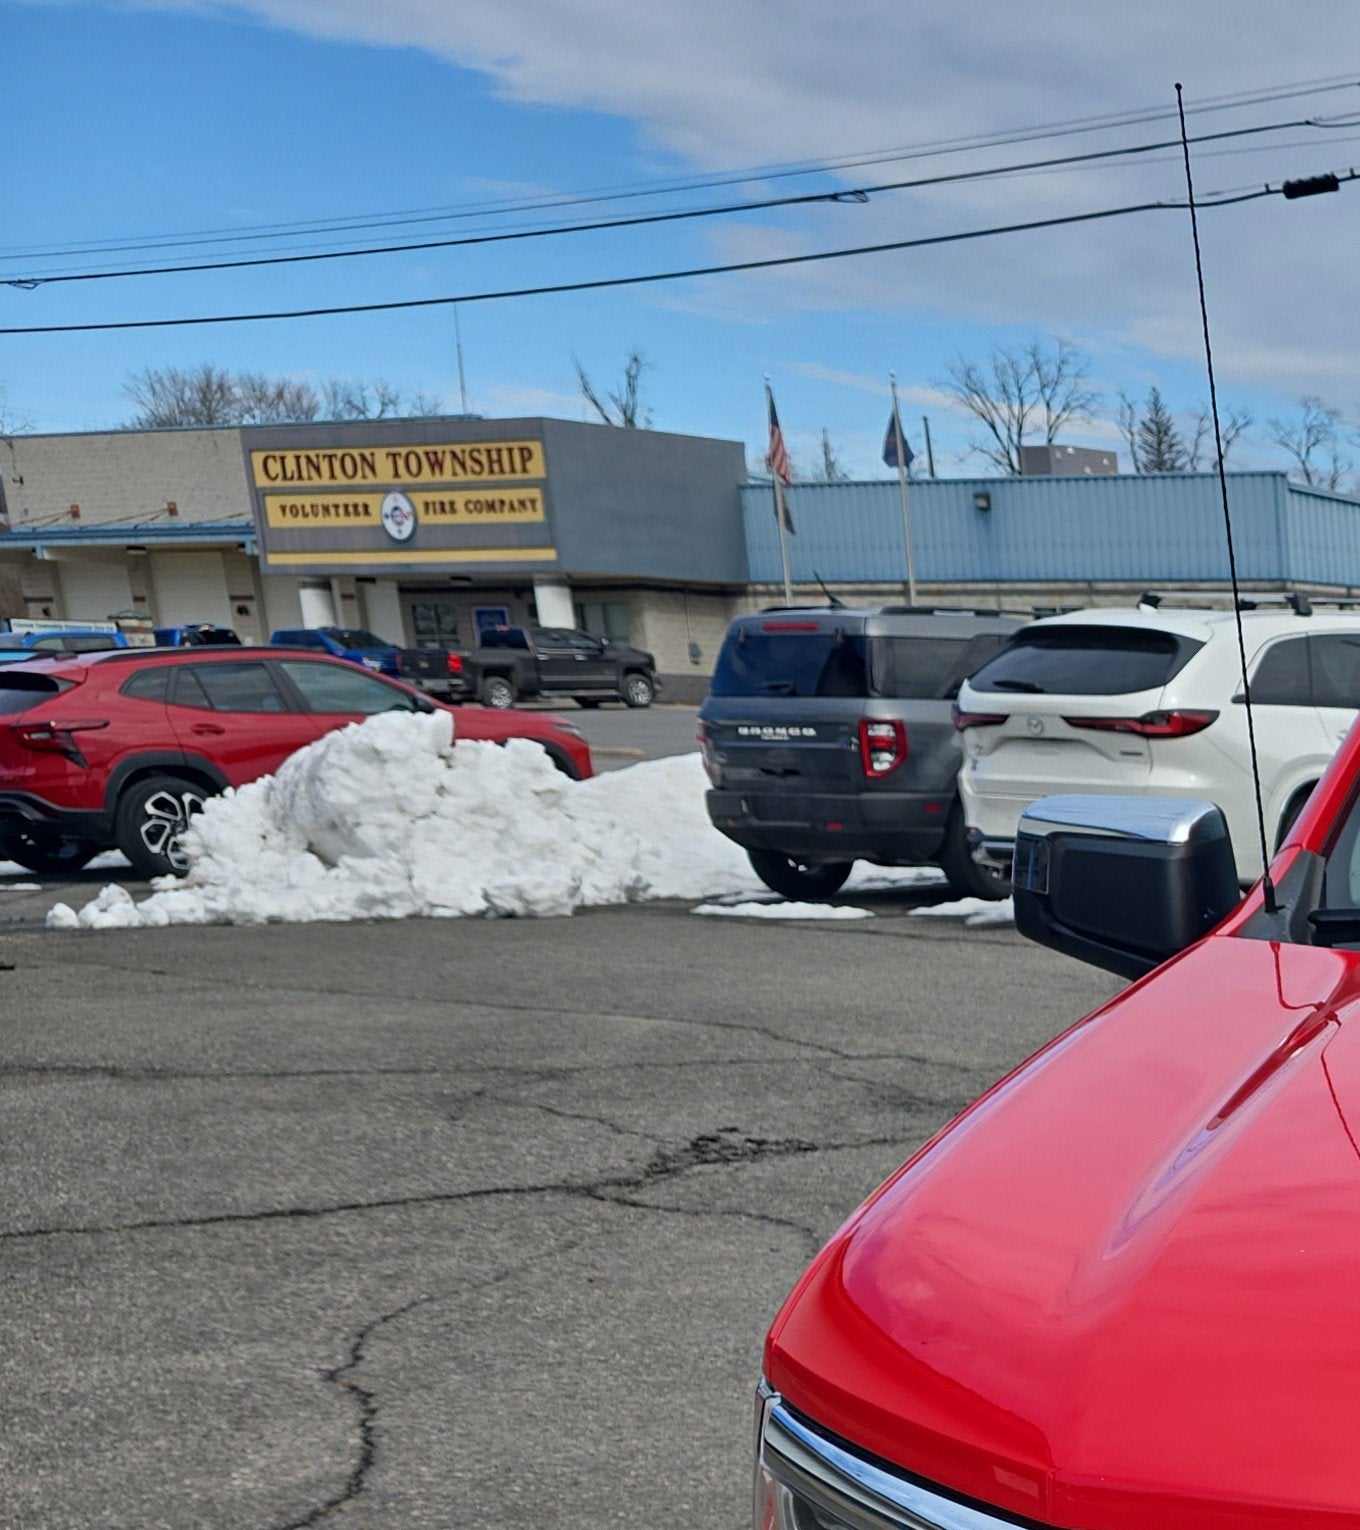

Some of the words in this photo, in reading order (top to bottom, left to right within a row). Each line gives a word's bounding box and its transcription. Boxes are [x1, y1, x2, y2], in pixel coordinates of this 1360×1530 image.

[262, 451, 378, 482] CLINTON
[386, 445, 534, 480] TOWNSHIP
[279, 502, 371, 519] VOLUNTEER
[423, 499, 458, 517] FIRE
[464, 497, 539, 515] COMPANY
